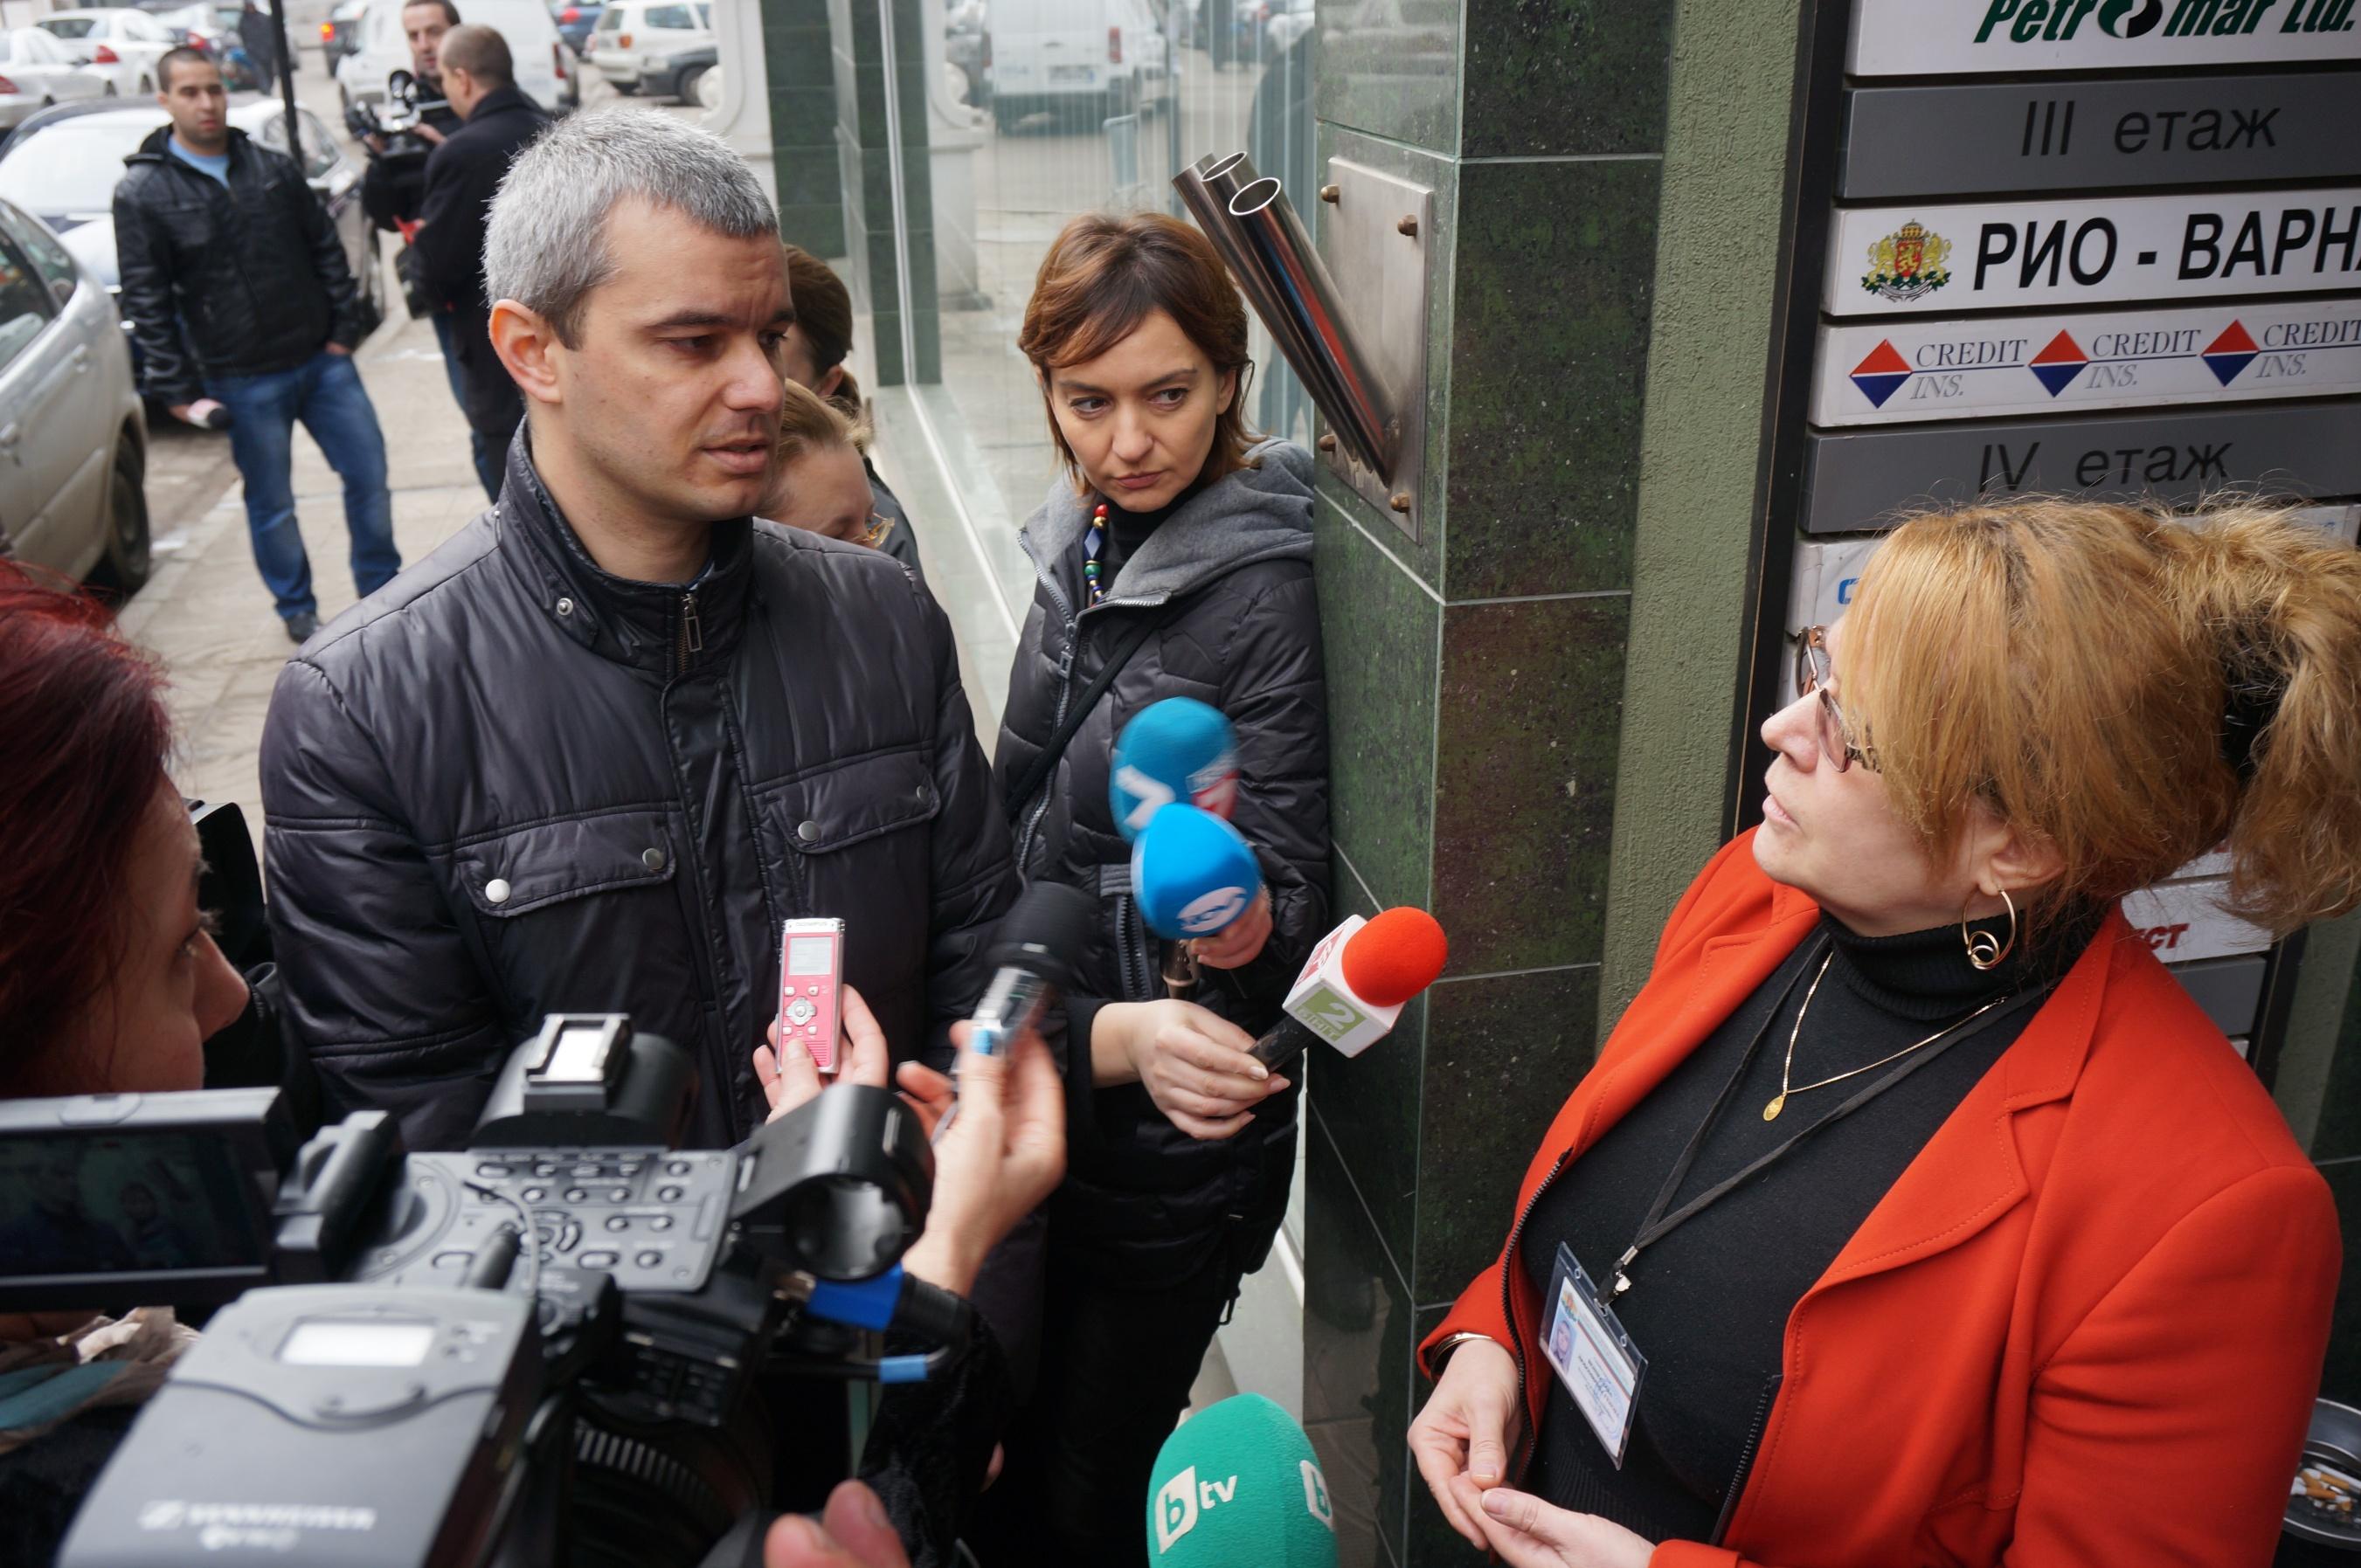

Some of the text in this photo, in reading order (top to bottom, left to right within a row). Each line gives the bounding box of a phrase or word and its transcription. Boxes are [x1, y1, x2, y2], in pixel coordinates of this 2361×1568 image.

[2114, 107, 2281, 154] етаж
[1973, 217, 2118, 291] РИО
[2178, 206, 2361, 280] ВАРН
[1916, 339, 2027, 368] CREDIT
[2092, 329, 2201, 357] CREDIT
[2085, 363, 2138, 390] INS.
[2255, 354, 2307, 378] INS.
[1909, 374, 1964, 400] INS.
[1978, 442, 2233, 494] IV етаж
[1316, 1002, 1355, 1030] 2
